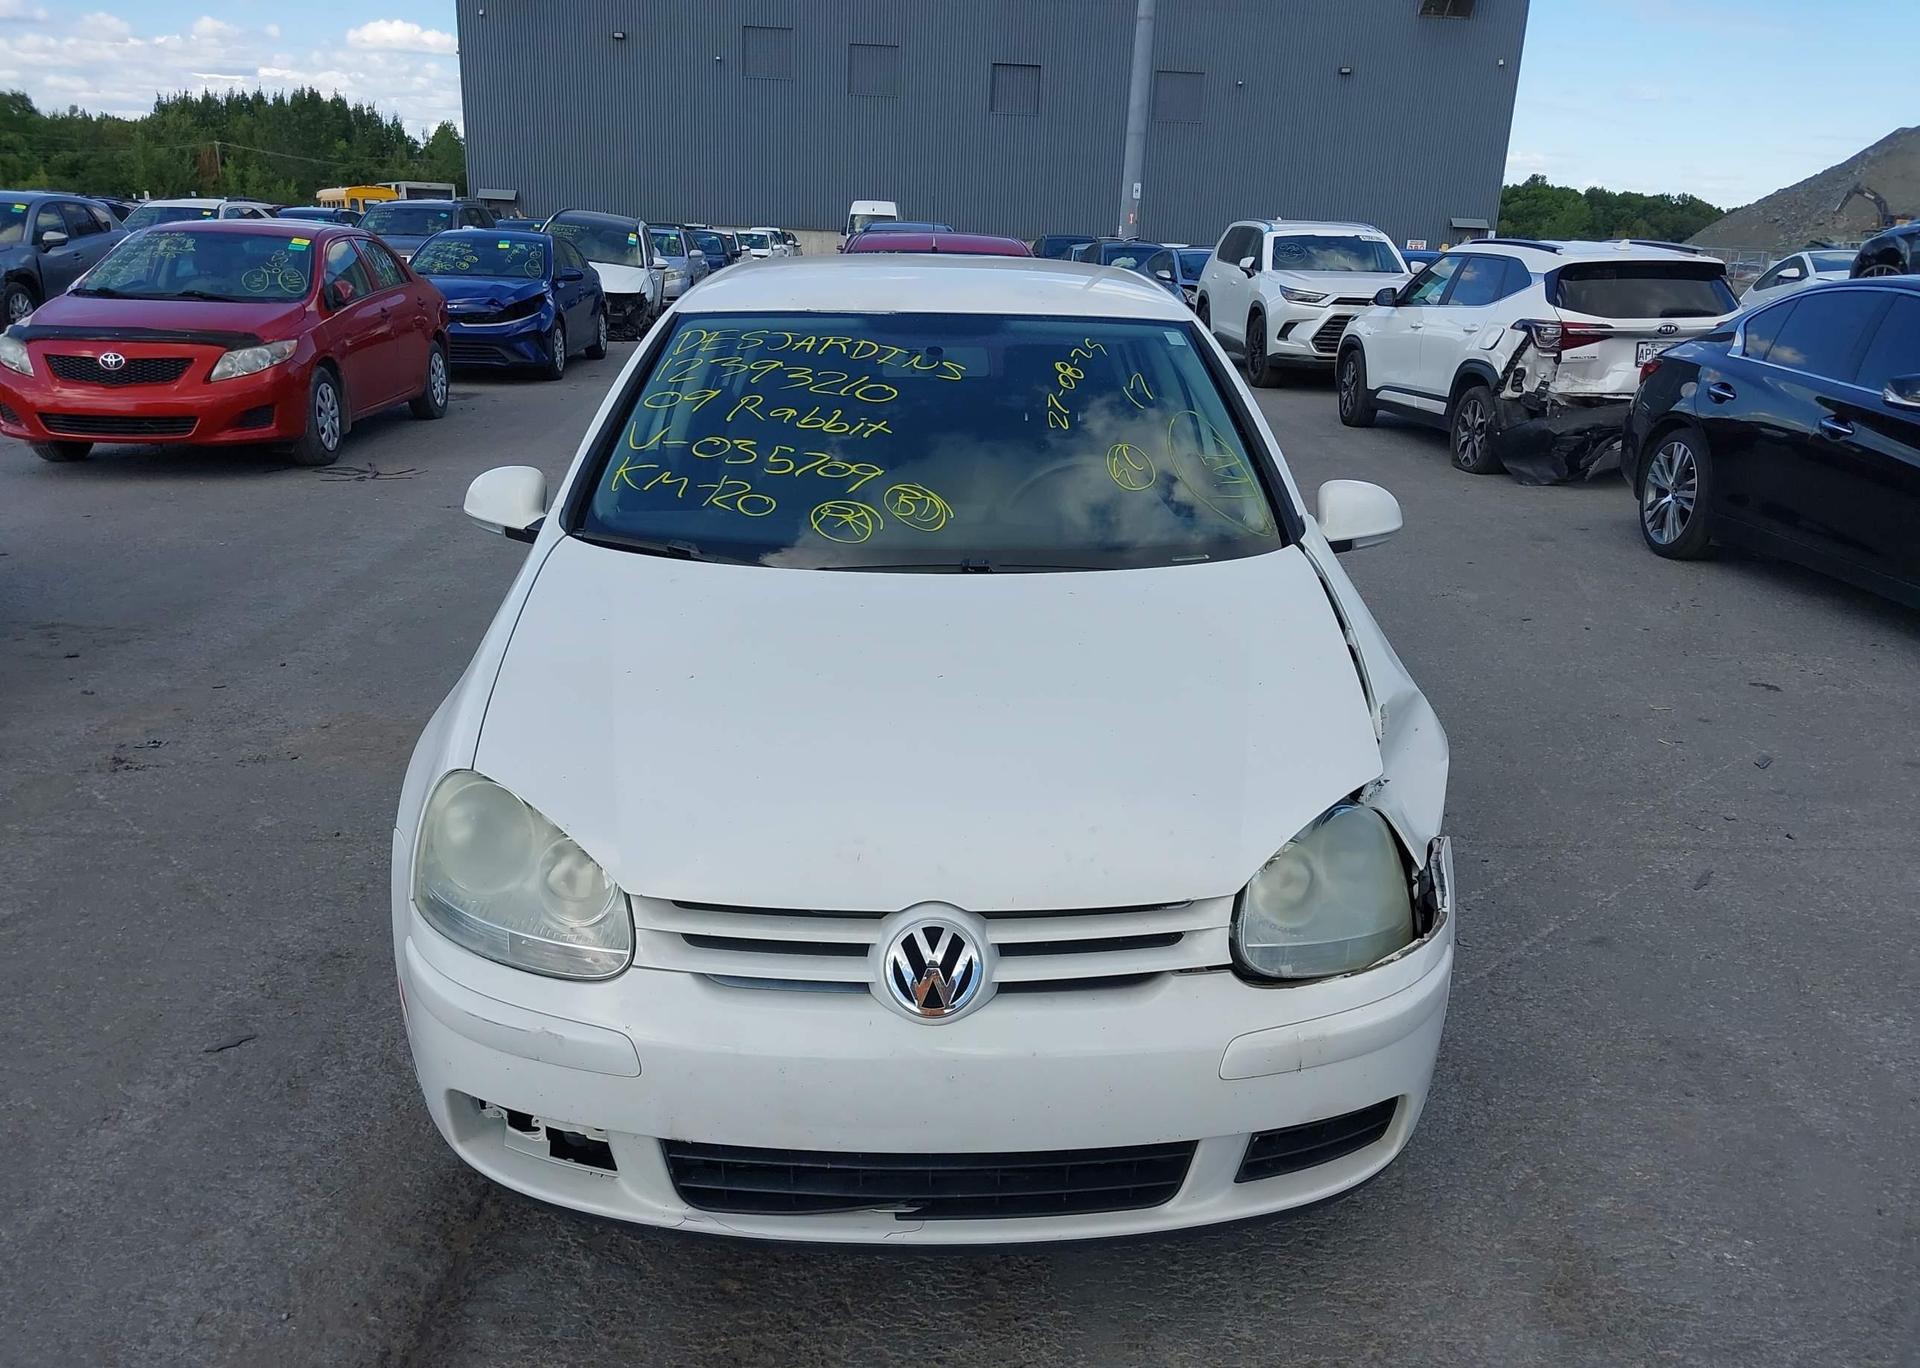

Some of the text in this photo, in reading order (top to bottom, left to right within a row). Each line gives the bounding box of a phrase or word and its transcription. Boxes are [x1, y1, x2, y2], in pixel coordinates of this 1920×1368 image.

[1660, 325, 1676, 334] KIA
[655, 356, 900, 403] 12393210
[672, 329, 967, 381] DESJARDINS
[643, 388, 893, 438] 09 Rabbit
[889, 922, 978, 1014] VW
